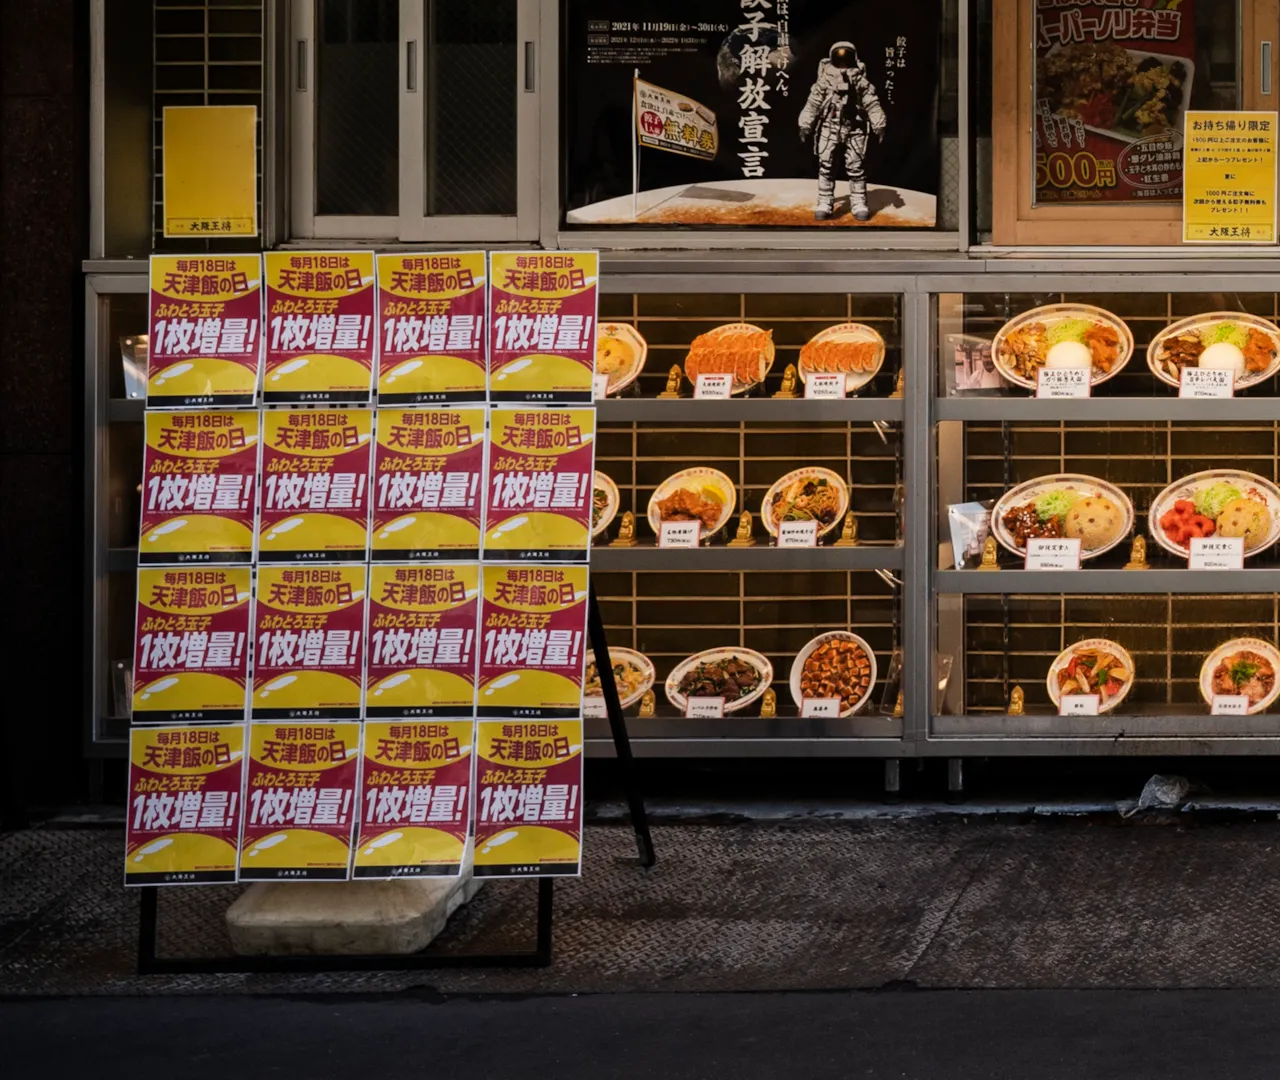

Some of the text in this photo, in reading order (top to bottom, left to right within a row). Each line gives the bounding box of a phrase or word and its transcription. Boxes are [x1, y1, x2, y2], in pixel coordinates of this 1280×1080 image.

[896, 36, 907, 68] 餃子は
[663, 117, 715, 151] 無料券
[1192, 120, 1271, 132] お持ち帰り限定
[190, 221, 232, 232] 大阪王将
[1209, 226, 1251, 238] 大阪王将
[177, 260, 236, 272] 毎月18日は
[290, 257, 349, 269] 毎月18日は
[402, 258, 461, 270] 毎月18日は
[516, 256, 574, 269] 毎月18日は
[163, 272, 249, 296] 天津飯の日
[277, 269, 363, 292] 天津飯の日
[390, 269, 474, 293] 天津飯の日
[503, 269, 586, 292] 天津飯の日
[155, 303, 224, 317] ふわとろ玉子
[272, 300, 338, 314] ふわとろ玉子
[154, 318, 258, 354] 1枚増量!
[271, 315, 371, 350] 1枚増量!
[384, 315, 482, 352] 1枚増量!
[495, 315, 592, 350] 1枚増量!
[158, 428, 245, 451] 天津飯の日
[275, 426, 359, 449] 天津飯の日
[388, 425, 472, 449] 天津飯の日
[501, 426, 582, 448] 天津飯の日
[147, 474, 253, 510] 1枚増量!
[266, 473, 366, 509] 1枚増量!
[378, 472, 479, 508] 1枚増量!
[492, 472, 589, 507] 1枚増量!
[150, 584, 238, 608] 天津飯の日
[268, 583, 353, 607] 天津飯の日
[381, 581, 466, 605] 天津飯の日
[494, 582, 575, 606] 天津飯の日
[140, 631, 245, 668] 1枚増量!
[259, 630, 360, 666] 1枚増量!
[372, 628, 473, 665] 1枚増量!
[485, 629, 581, 665] 1枚増量!
[142, 744, 231, 768] 天津飯の日
[261, 741, 346, 764] 天津飯の日
[375, 738, 461, 762] 天津飯の日
[489, 737, 570, 762] 天津飯の日
[133, 792, 237, 830] 1枚増量!
[250, 788, 352, 825] 1枚増量!
[365, 786, 466, 822] 1枚増量!
[480, 785, 578, 821] 1枚増量!
